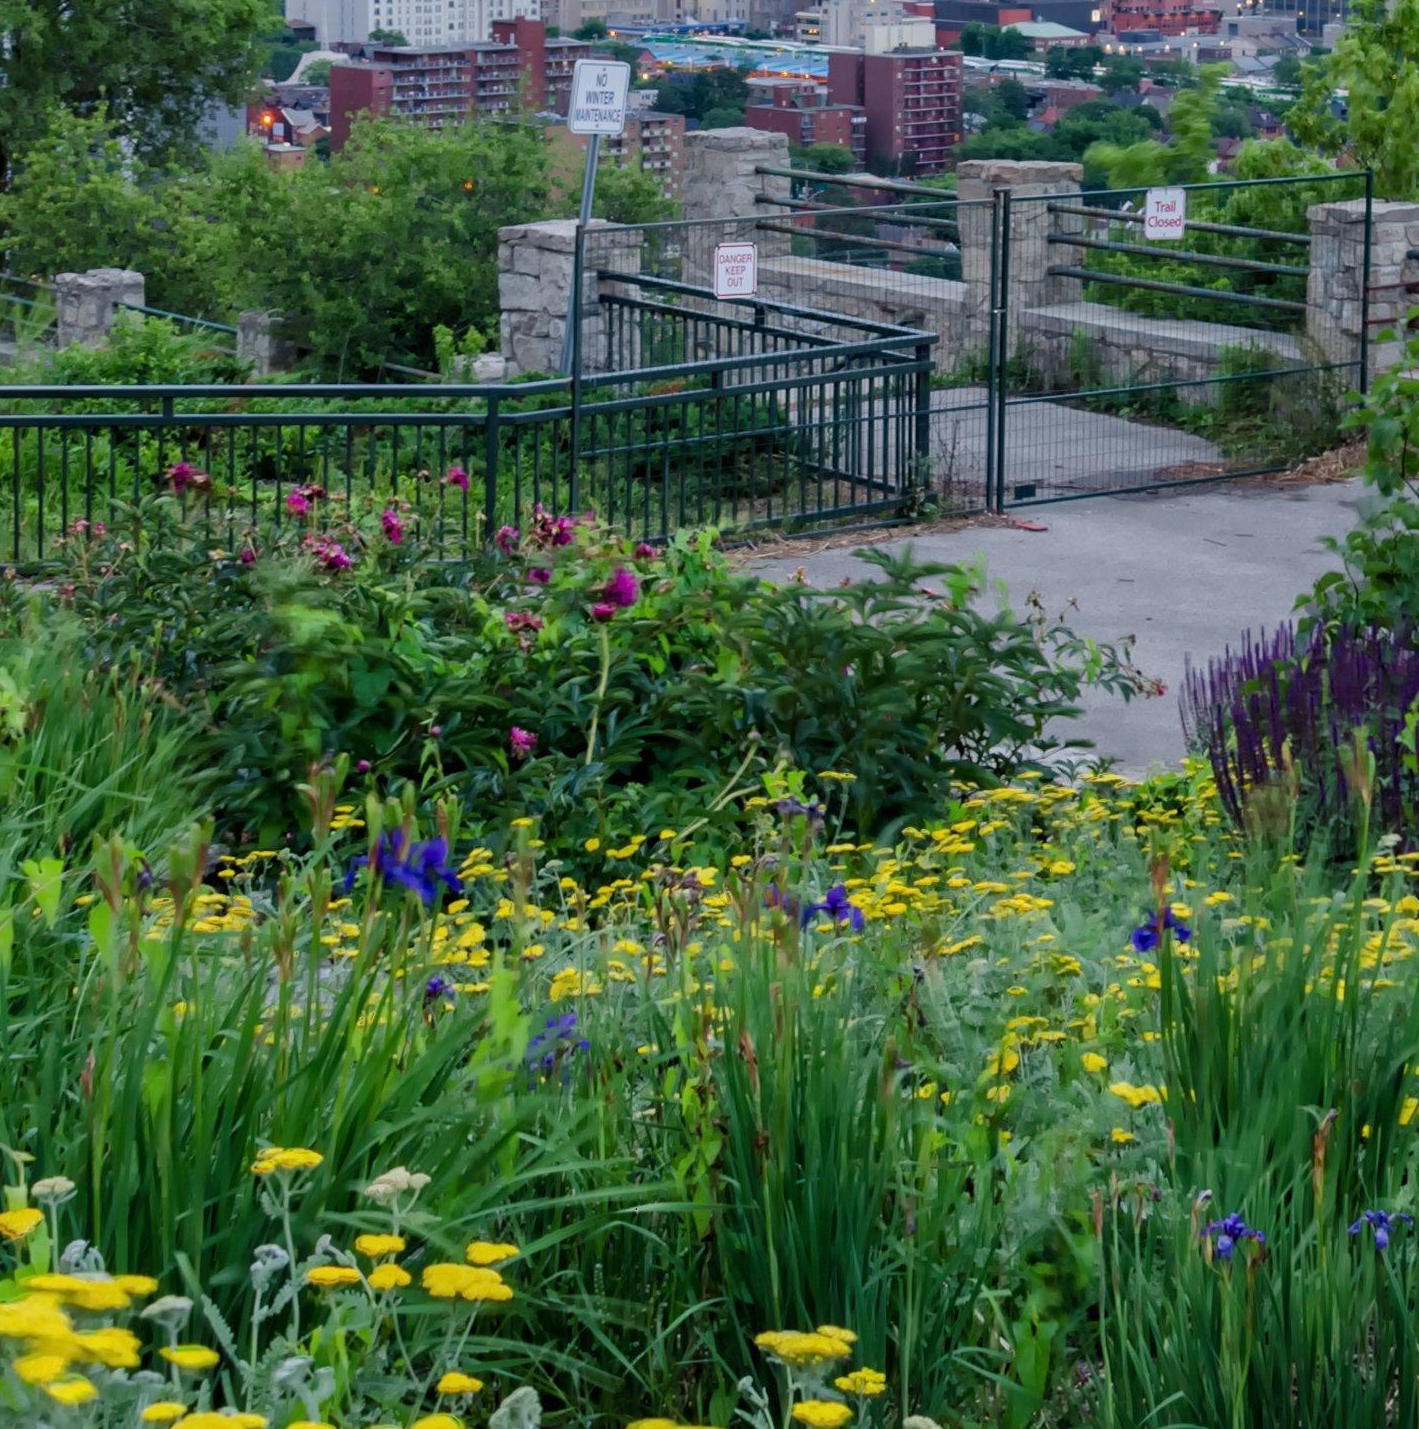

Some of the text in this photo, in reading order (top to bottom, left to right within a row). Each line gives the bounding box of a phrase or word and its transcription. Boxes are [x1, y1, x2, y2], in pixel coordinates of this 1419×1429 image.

[596, 73, 608, 87] NO
[585, 91, 614, 105] WINTER
[574, 108, 621, 122] MAINTENANCE
[1155, 200, 1176, 212] Trail
[1148, 216, 1182, 227] Closed
[718, 254, 753, 265] DANGER
[725, 266, 747, 275] KEEP
[727, 277, 744, 287] OUT
